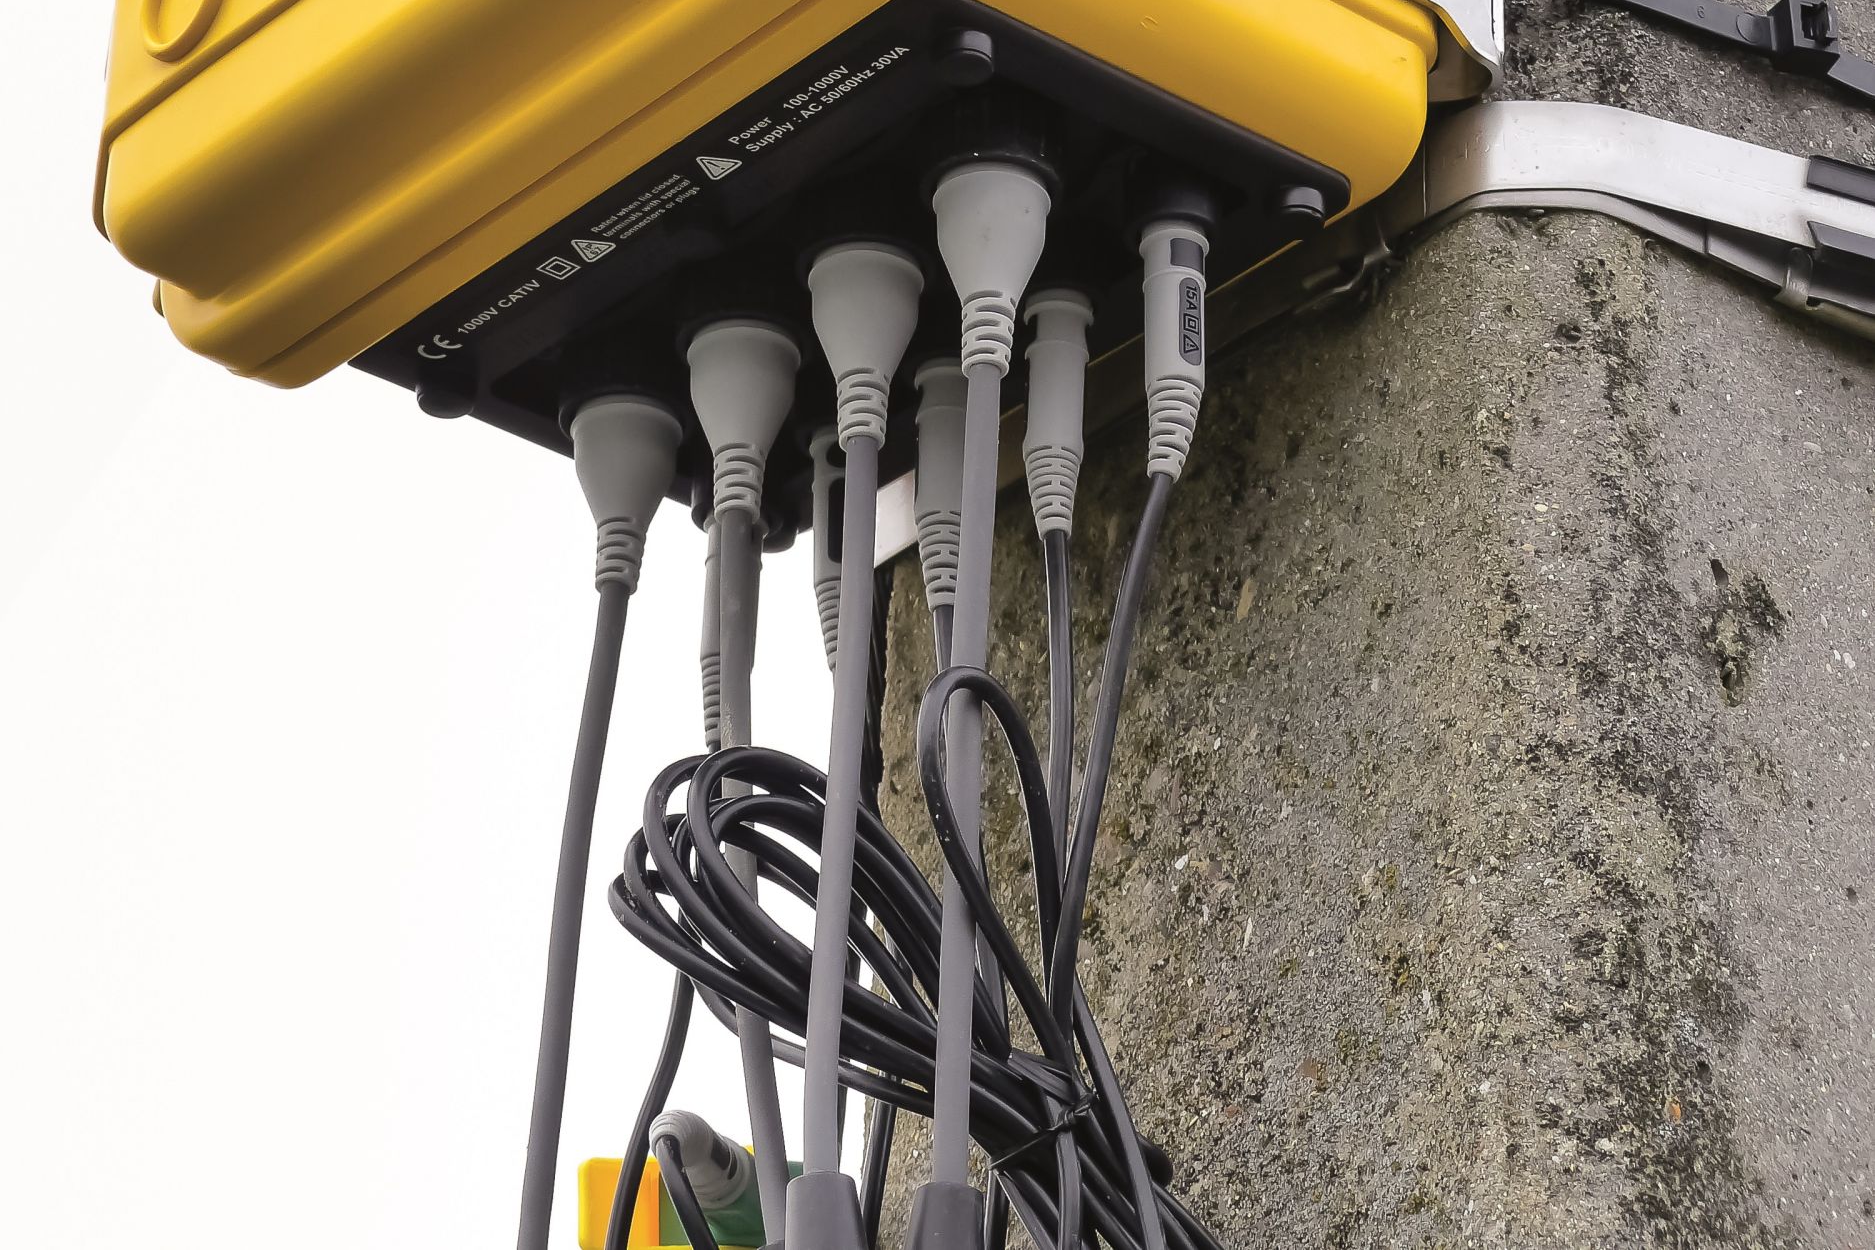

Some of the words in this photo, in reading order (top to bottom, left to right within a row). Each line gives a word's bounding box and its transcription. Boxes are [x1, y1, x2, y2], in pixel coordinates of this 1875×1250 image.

[728, 116, 772, 145] Power
[783, 65, 849, 110] 100-1000V
[745, 120, 794, 152] Supply
[800, 103, 823, 119] AC
[820, 68, 876, 104] 50/60Hz
[871, 46, 910, 70] 30VA
[591, 215, 618, 233] Rated
[616, 200, 641, 217] when
[602, 211, 643, 237] terminals
[641, 199, 661, 212] with
[619, 209, 666, 239] connectors
[1186, 285, 1198, 310] 15A
[457, 306, 499, 335] 1000V
